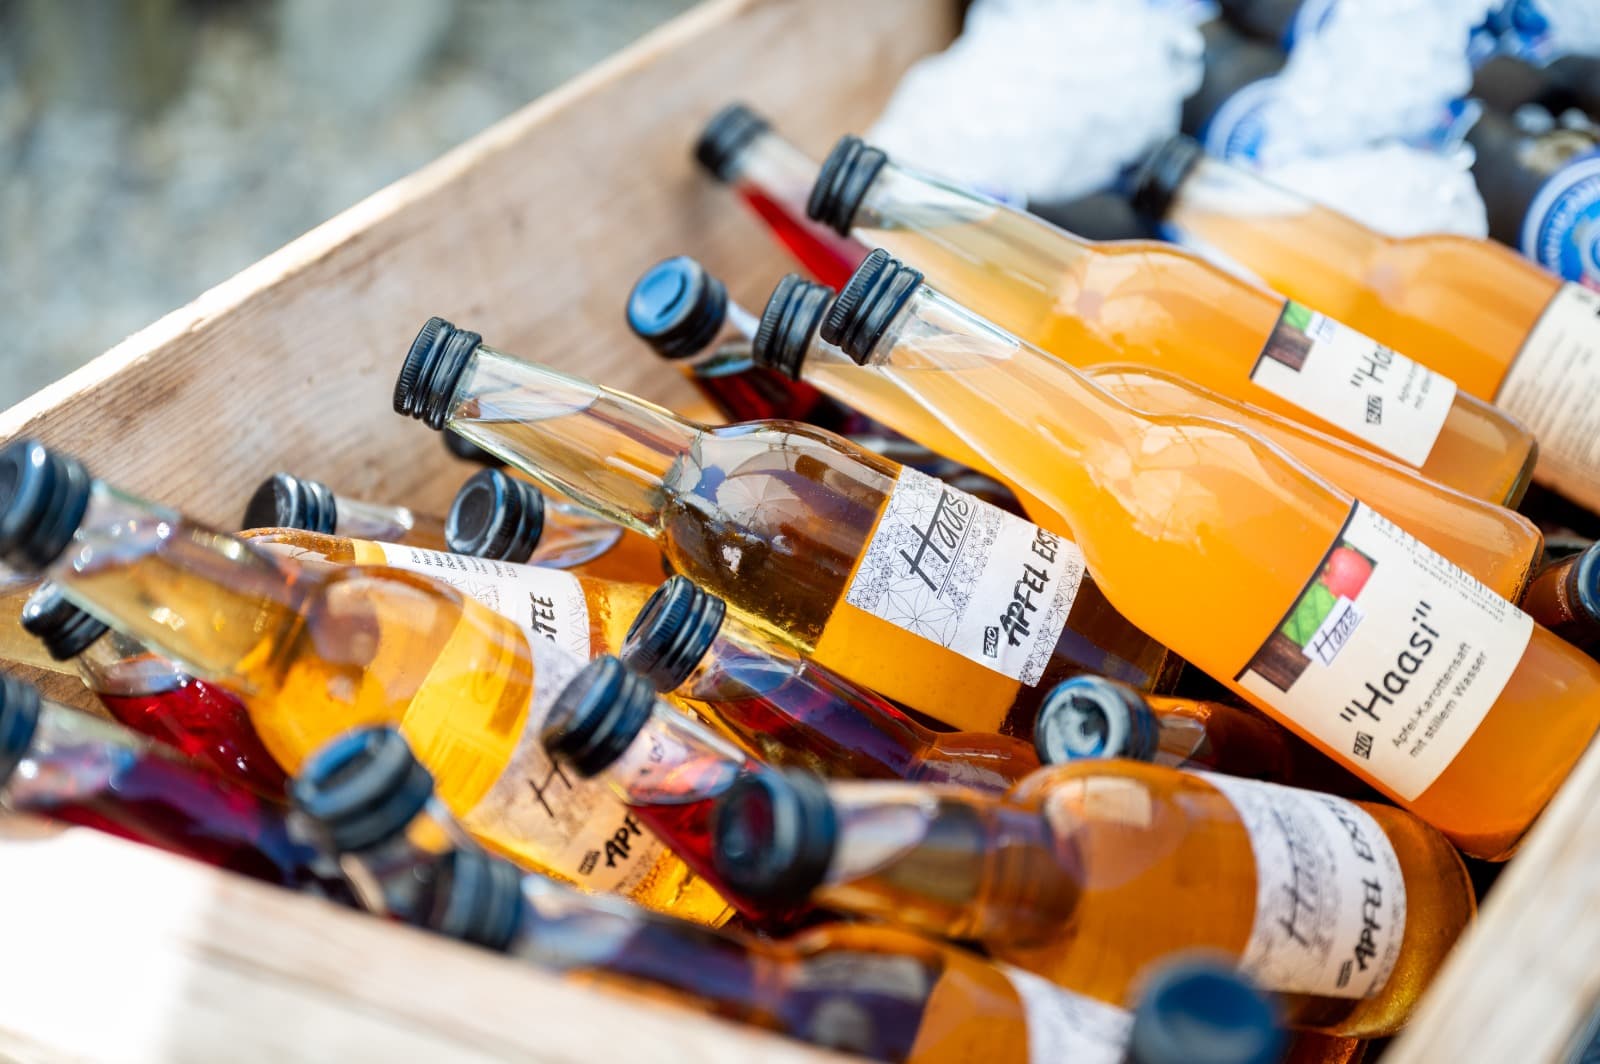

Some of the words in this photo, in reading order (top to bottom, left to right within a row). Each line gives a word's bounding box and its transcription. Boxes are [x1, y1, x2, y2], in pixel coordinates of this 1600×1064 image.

[900, 489, 970, 593] Haas
[1000, 563, 1050, 647] APFEL
[1031, 527, 1060, 564] EIST
[983, 625, 999, 658] BIO
[1313, 604, 1360, 662] Haas
[1340, 601, 1440, 722] "Haasi"
[1392, 642, 1471, 748] Apfel-Karottensaft
[1410, 738, 1427, 757] mit
[1424, 698, 1457, 741] stillem
[1452, 650, 1488, 698] Wasser
